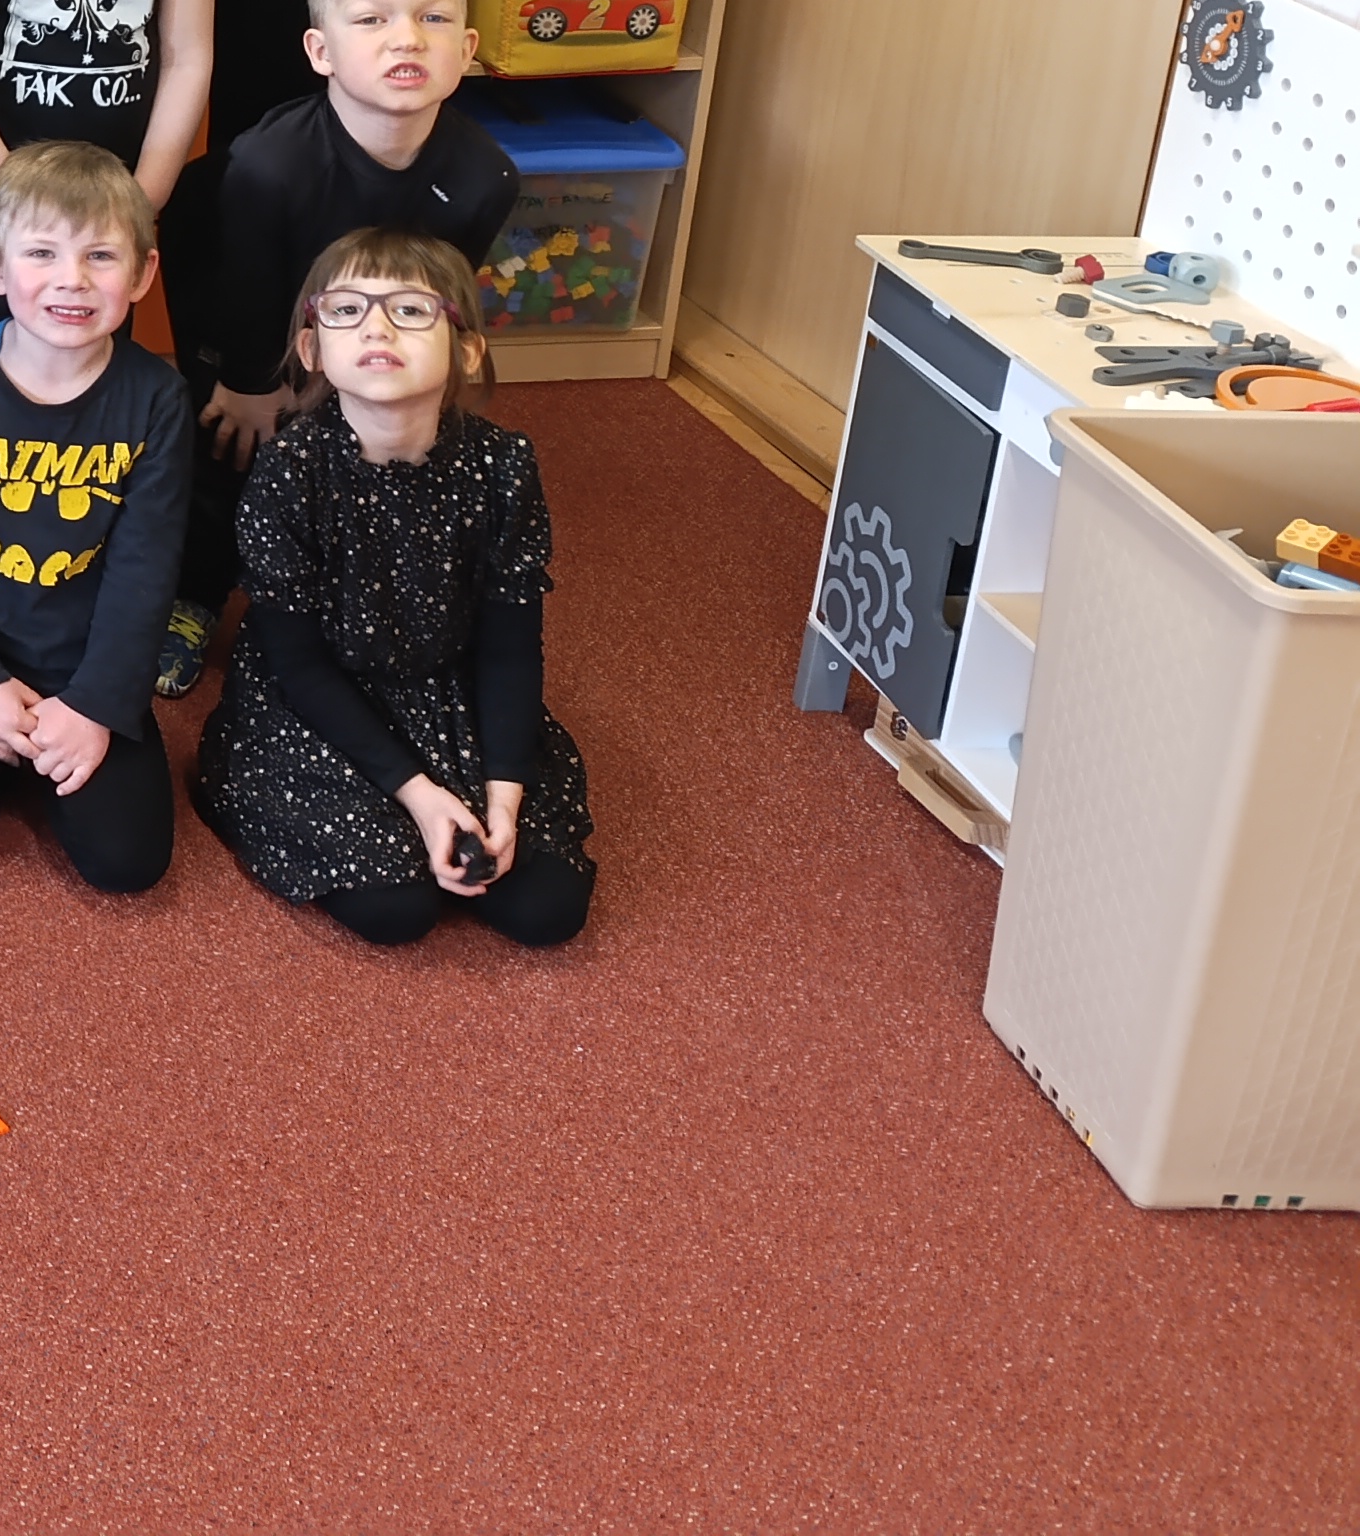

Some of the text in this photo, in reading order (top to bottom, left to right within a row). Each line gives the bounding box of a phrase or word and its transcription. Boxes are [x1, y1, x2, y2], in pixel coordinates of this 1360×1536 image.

[1192, 0, 1202, 11] 10
[1247, 3, 1254, 14] 1
[1182, 24, 1189, 34] 9
[1256, 30, 1264, 40] 2
[1181, 52, 1188, 62] 8
[1256, 61, 1263, 71] 3
[1191, 78, 1197, 88] 7
[11, 71, 77, 107] TAK
[1244, 85, 1251, 95] 4
[1206, 95, 1214, 105] 6
[1226, 97, 1233, 107] 5
